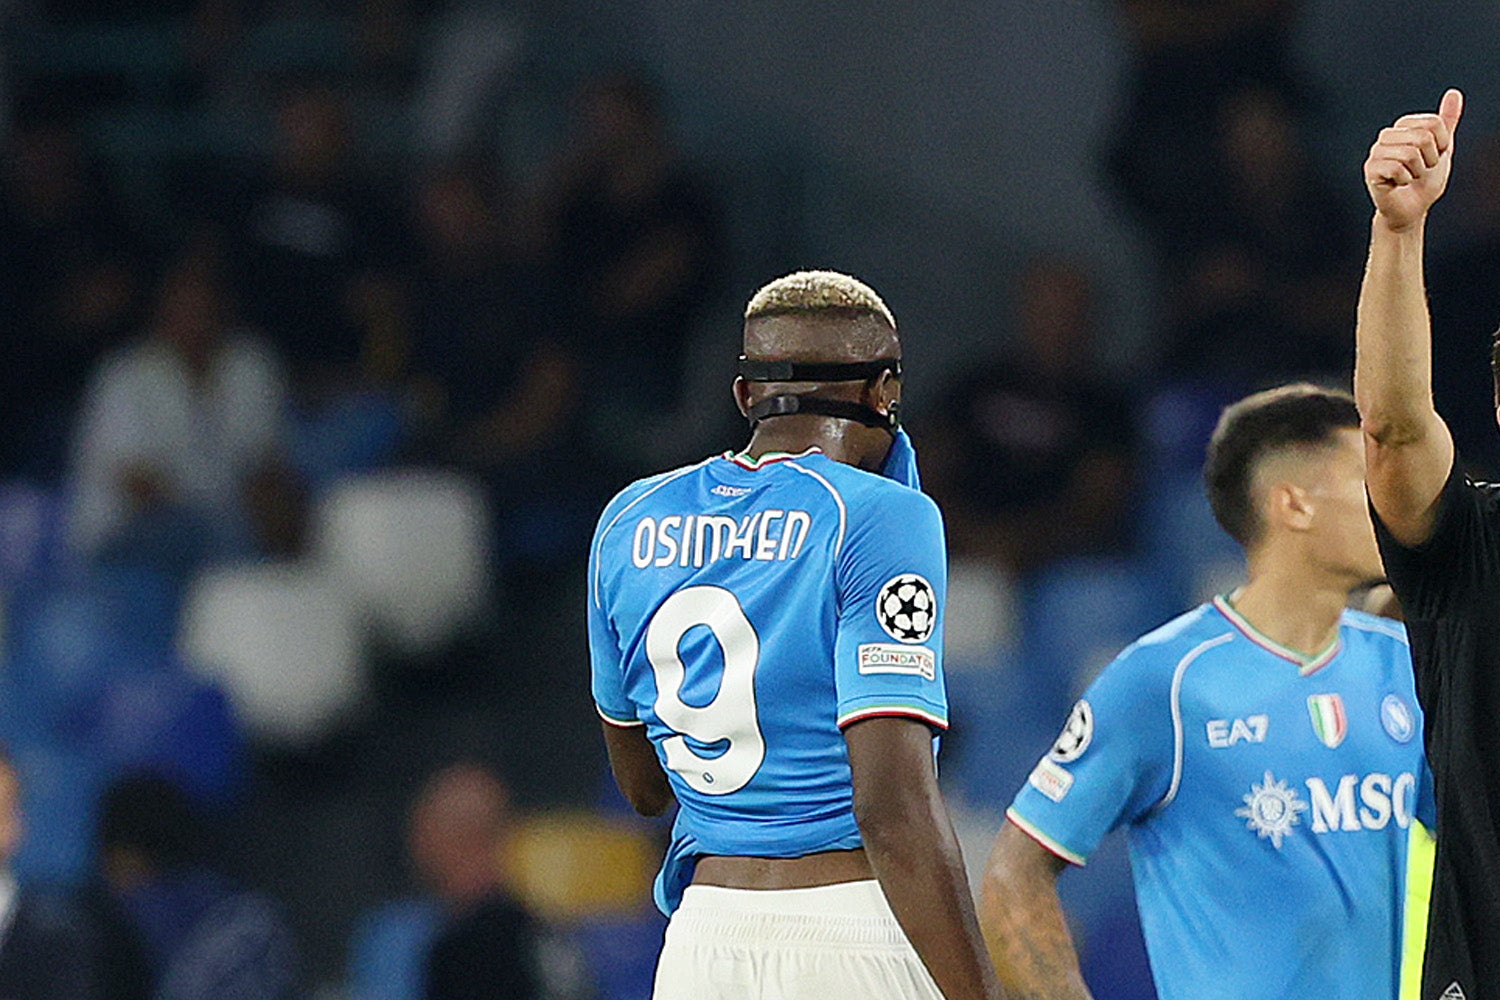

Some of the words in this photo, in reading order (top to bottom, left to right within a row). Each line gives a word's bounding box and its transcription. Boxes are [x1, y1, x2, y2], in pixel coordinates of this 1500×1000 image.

[632, 509, 812, 569] OSIMHEN
[645, 585, 766, 796] 9
[862, 653, 933, 669] FOUNDATO
[1206, 714, 1269, 749] EA7
[1305, 771, 1415, 834] MSC
